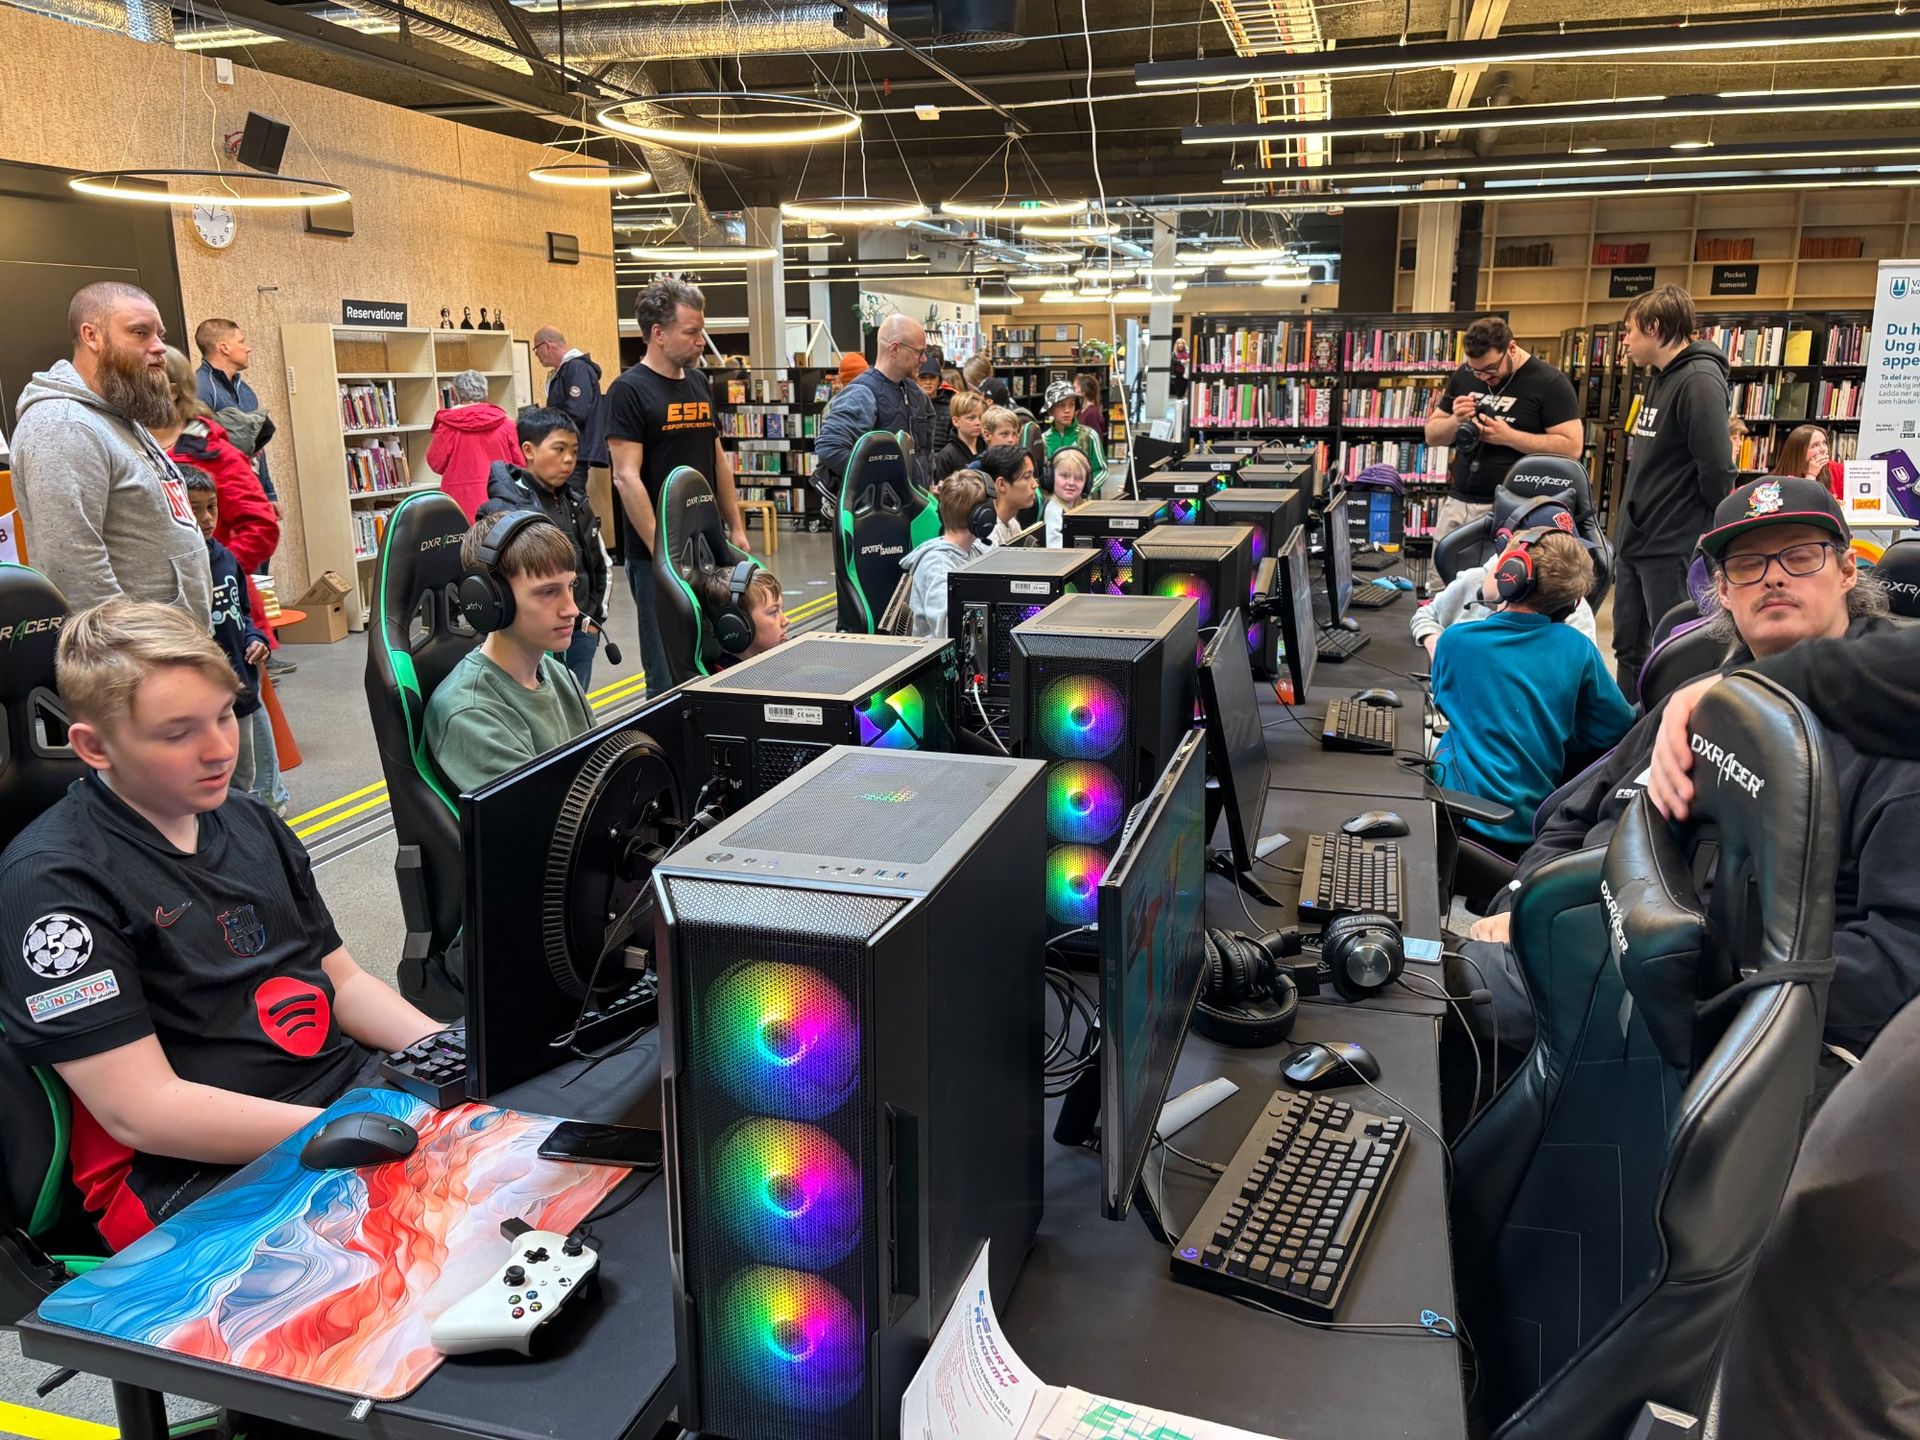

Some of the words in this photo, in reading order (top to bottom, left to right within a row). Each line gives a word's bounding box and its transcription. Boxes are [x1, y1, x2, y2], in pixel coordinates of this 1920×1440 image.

[346, 305, 404, 320] Reservationer
[1886, 323, 1907, 336] Du
[1884, 339, 1916, 354] Ung
[667, 401, 711, 422] ESA
[1513, 474, 1573, 490] DXRACER
[1879, 580, 1920, 603] DXR
[1690, 733, 1764, 799] DXRACER
[1600, 879, 1629, 955] DXRACER
[46, 932, 66, 960] 5
[28, 994, 45, 1004] UEFA
[30, 978, 115, 1014] FOUNDATION
